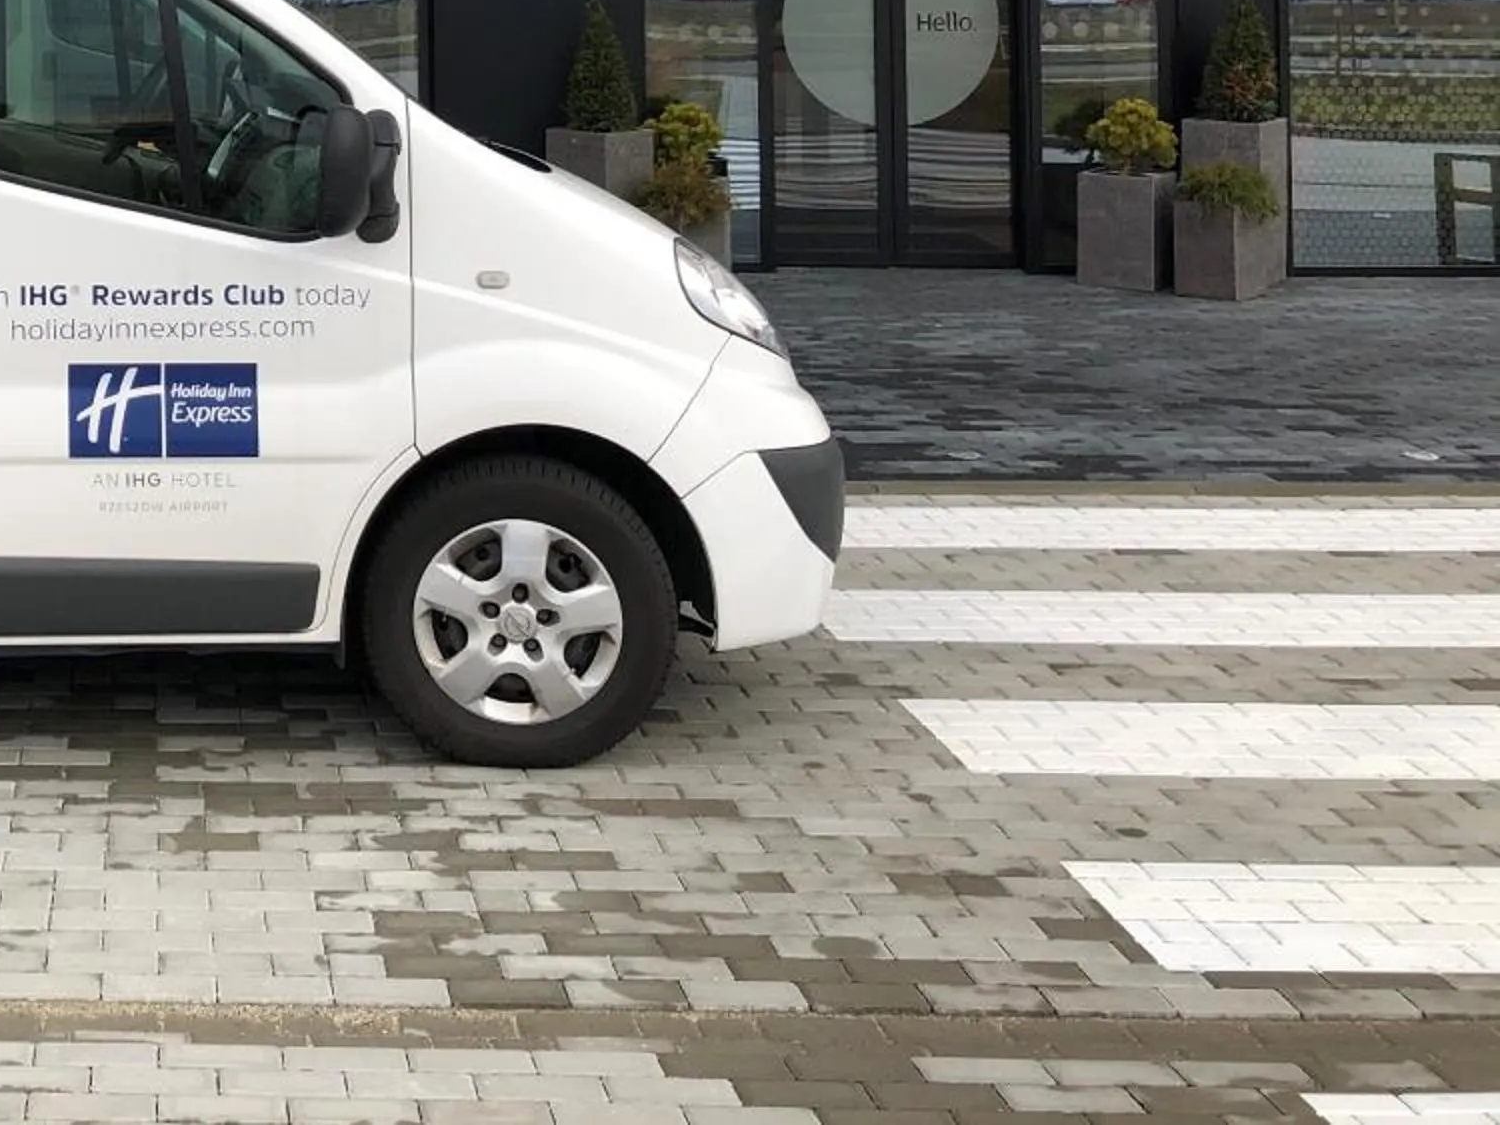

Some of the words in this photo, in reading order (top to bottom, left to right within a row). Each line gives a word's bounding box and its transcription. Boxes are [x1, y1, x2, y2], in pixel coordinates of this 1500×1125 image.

[916, 10, 978, 33] Hello.
[92, 284, 214, 307] Rewards
[223, 283, 285, 306] Club
[295, 284, 371, 309] today
[11, 316, 315, 342] holidayinnexpress.com
[170, 384, 226, 401] Holiday
[227, 383, 252, 398] Inn
[171, 401, 252, 427] Express
[92, 473, 119, 488] AN
[125, 472, 162, 488] IHG
[171, 472, 237, 488] HOTEL
